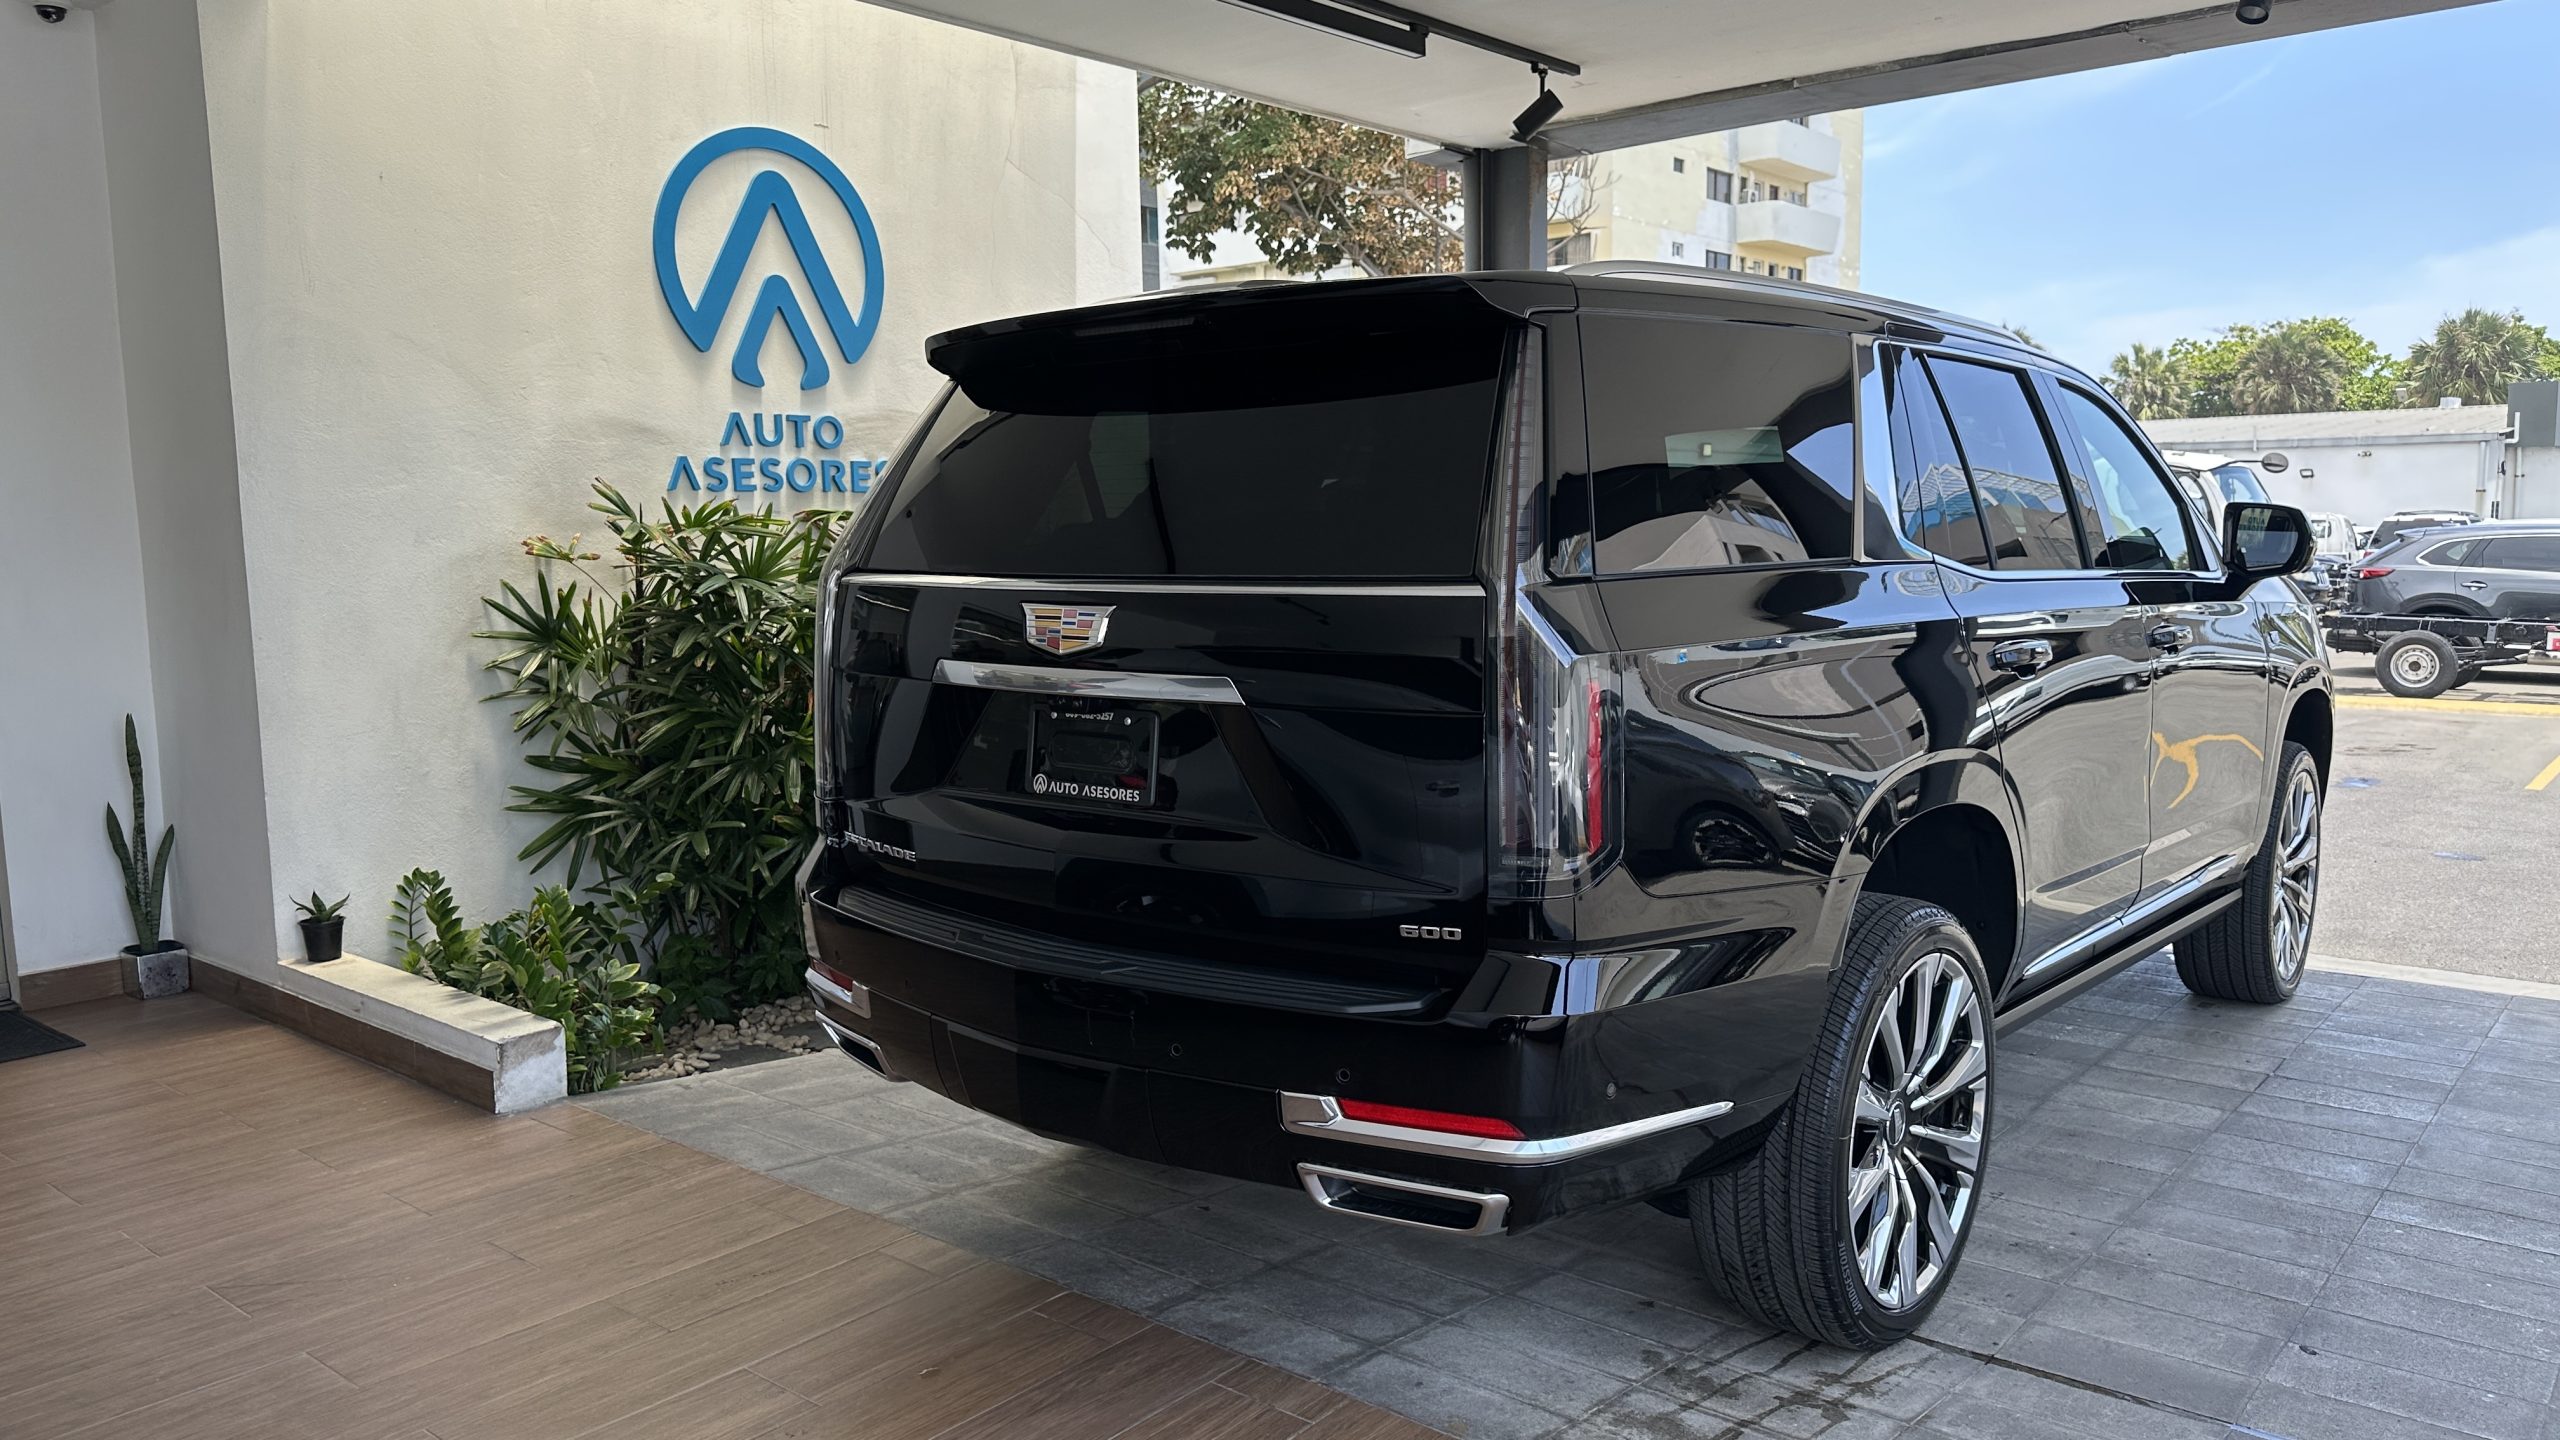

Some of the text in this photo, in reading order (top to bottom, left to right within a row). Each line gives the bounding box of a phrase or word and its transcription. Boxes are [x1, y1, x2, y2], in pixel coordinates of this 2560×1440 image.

[720, 412, 844, 449] AUTO
[1049, 781, 1140, 802] AUTO ASESORES
[843, 830, 917, 862] ESCALADE
[1399, 924, 1462, 941] 600
